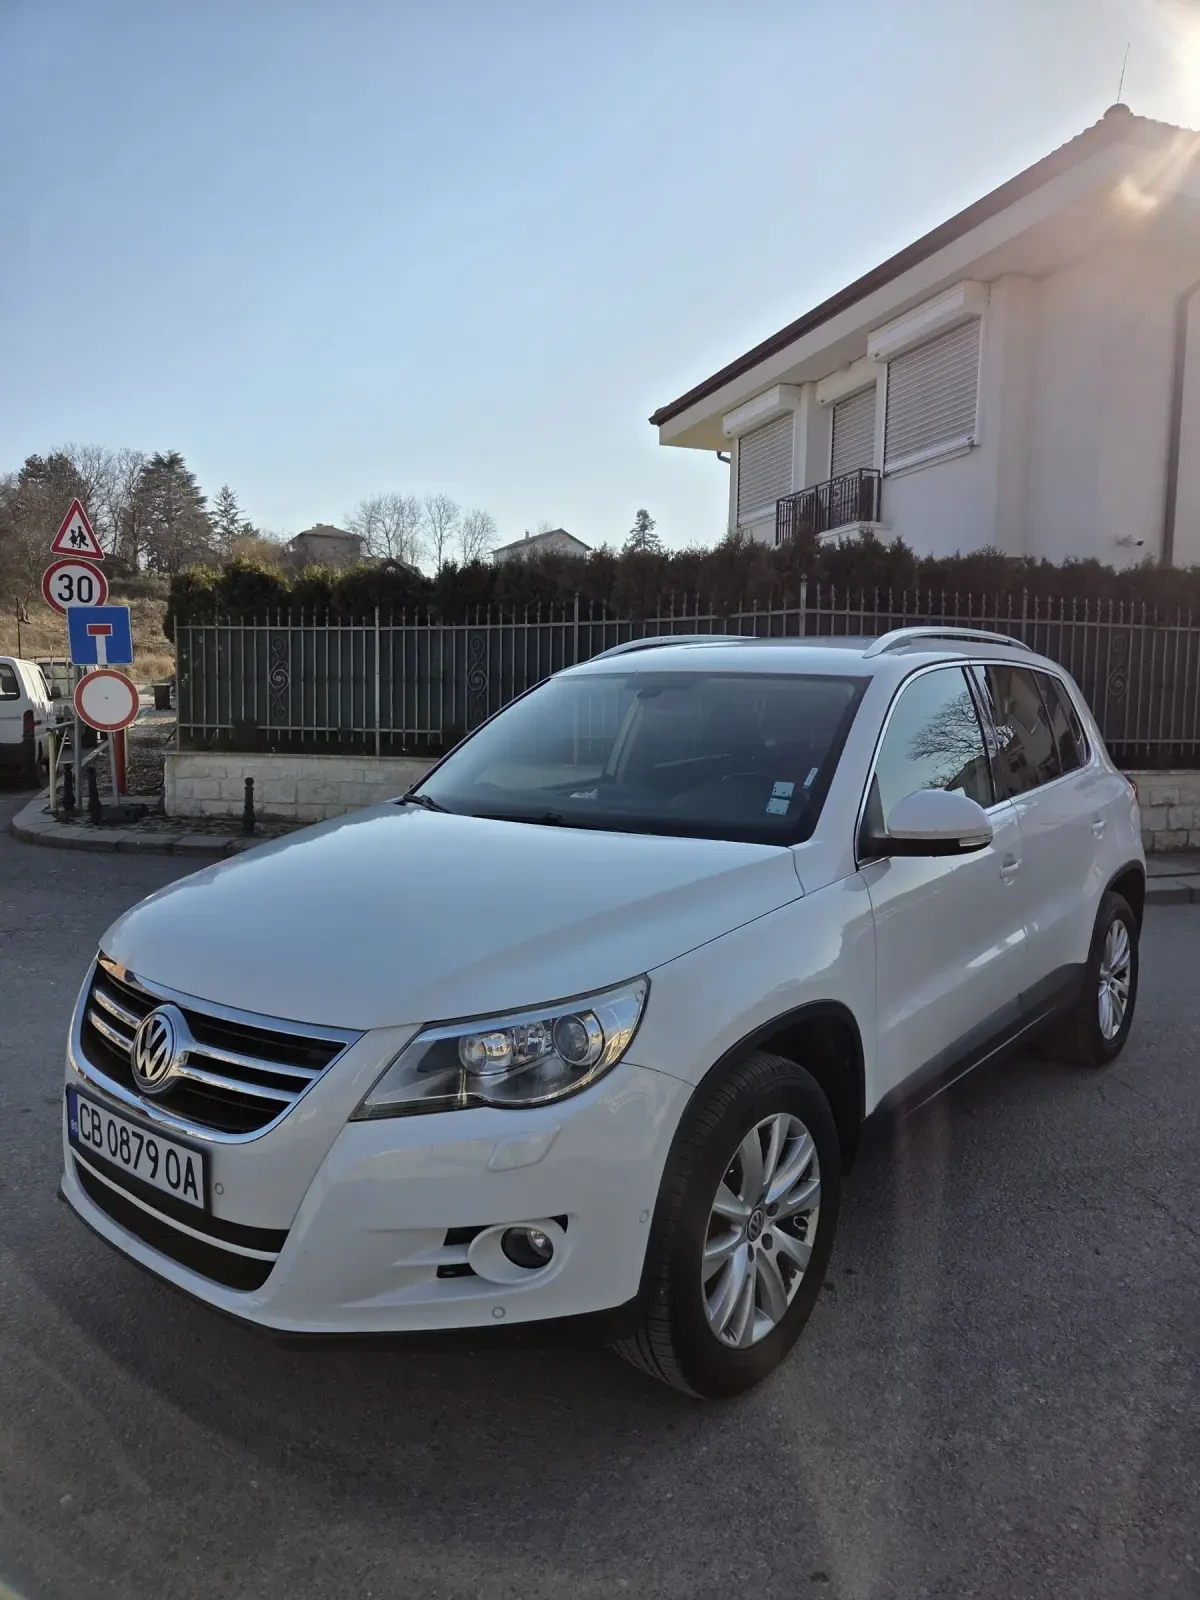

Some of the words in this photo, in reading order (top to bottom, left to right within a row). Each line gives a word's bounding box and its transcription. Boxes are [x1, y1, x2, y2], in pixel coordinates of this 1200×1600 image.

[57, 573, 93, 603] 30
[136, 1014, 168, 1081] VW
[79, 1102, 103, 1148] CB
[107, 1119, 159, 1179] 0879
[165, 1148, 199, 1201] OA
